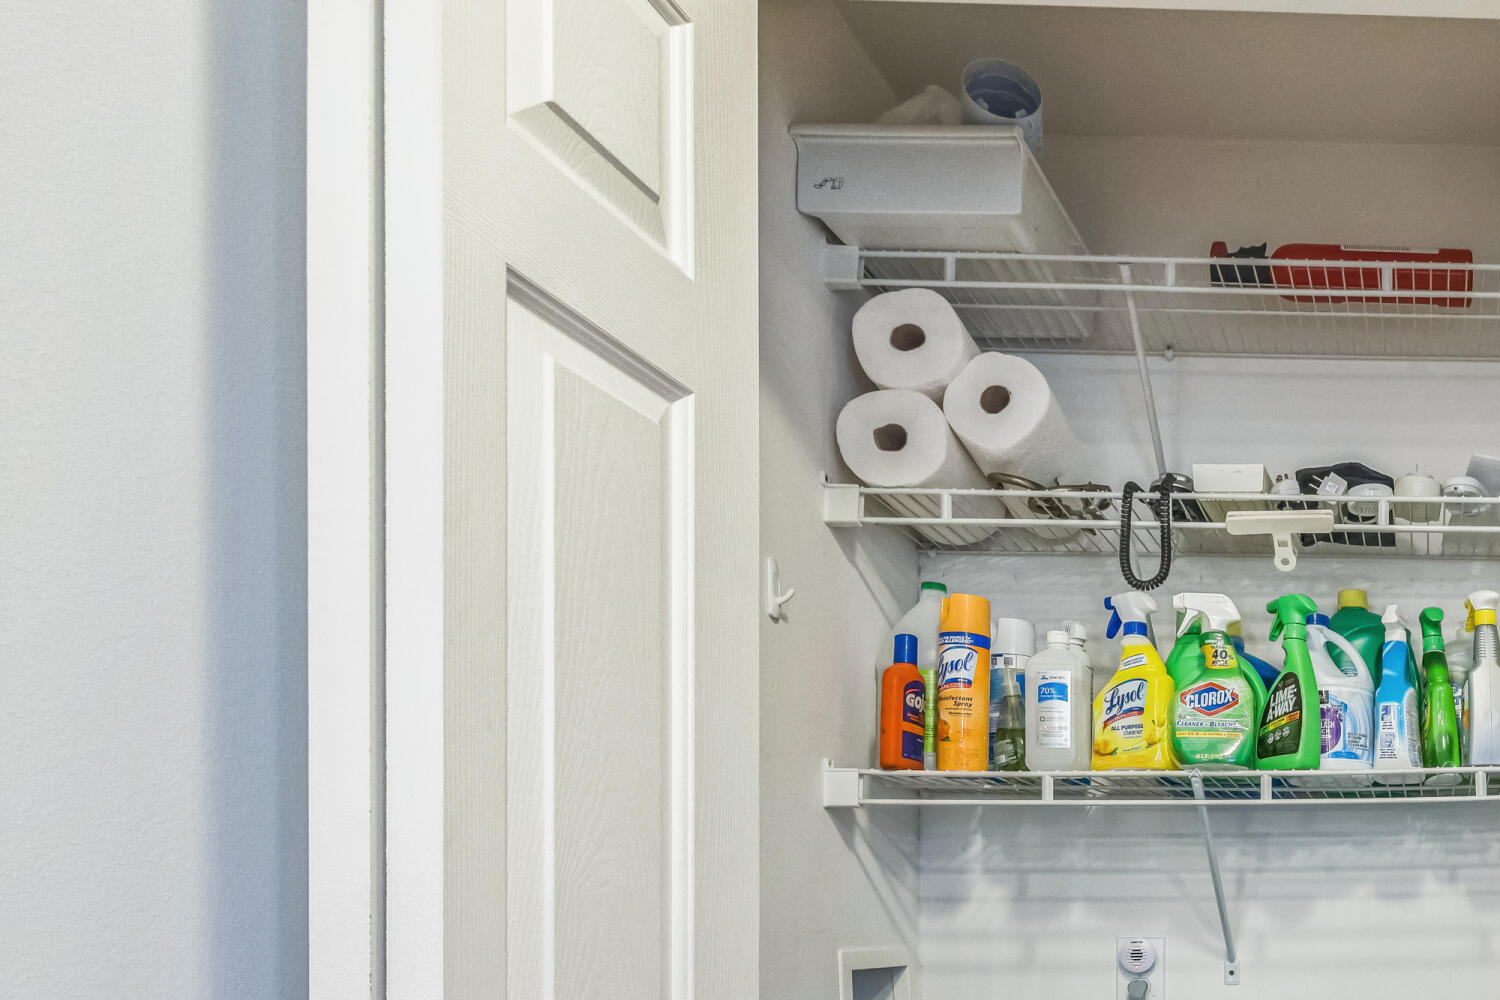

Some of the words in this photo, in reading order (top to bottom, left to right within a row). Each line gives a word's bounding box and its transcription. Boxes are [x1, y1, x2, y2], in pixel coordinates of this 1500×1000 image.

[906, 693, 925, 712] GOJ
[1104, 681, 1144, 715] Lysol
[1186, 689, 1233, 709] CLOROX
